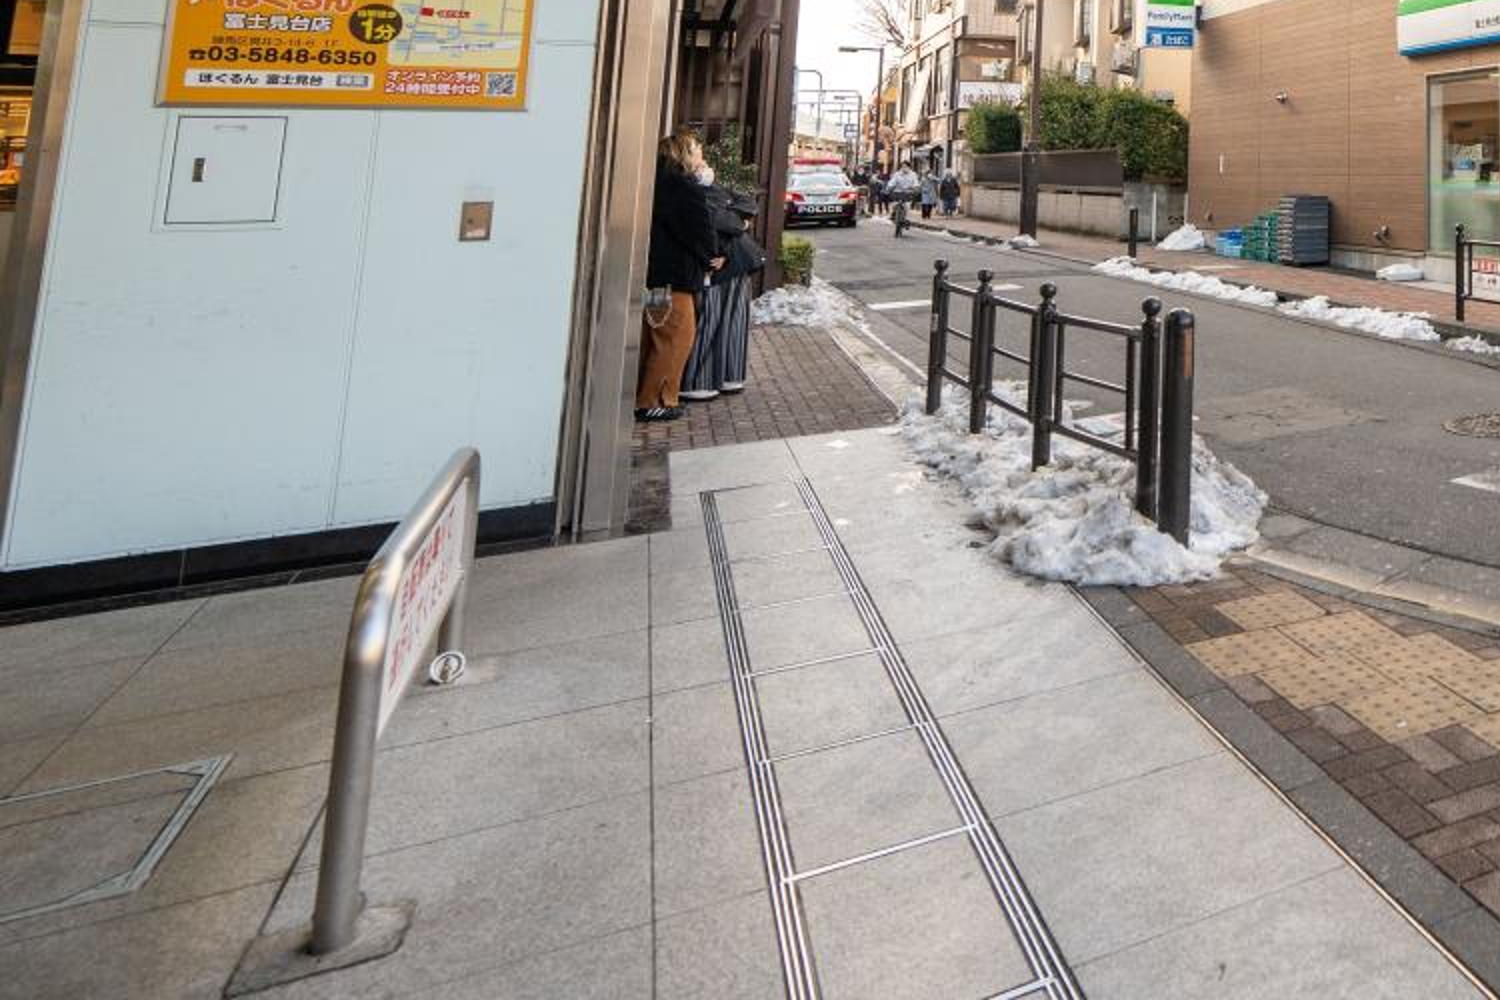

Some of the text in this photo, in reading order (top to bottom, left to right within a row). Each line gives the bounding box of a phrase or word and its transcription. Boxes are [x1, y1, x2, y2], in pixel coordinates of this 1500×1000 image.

[223, 13, 333, 32] 富士見台店
[208, 46, 377, 65] 03-5848-6350
[798, 204, 843, 214] POLICE
